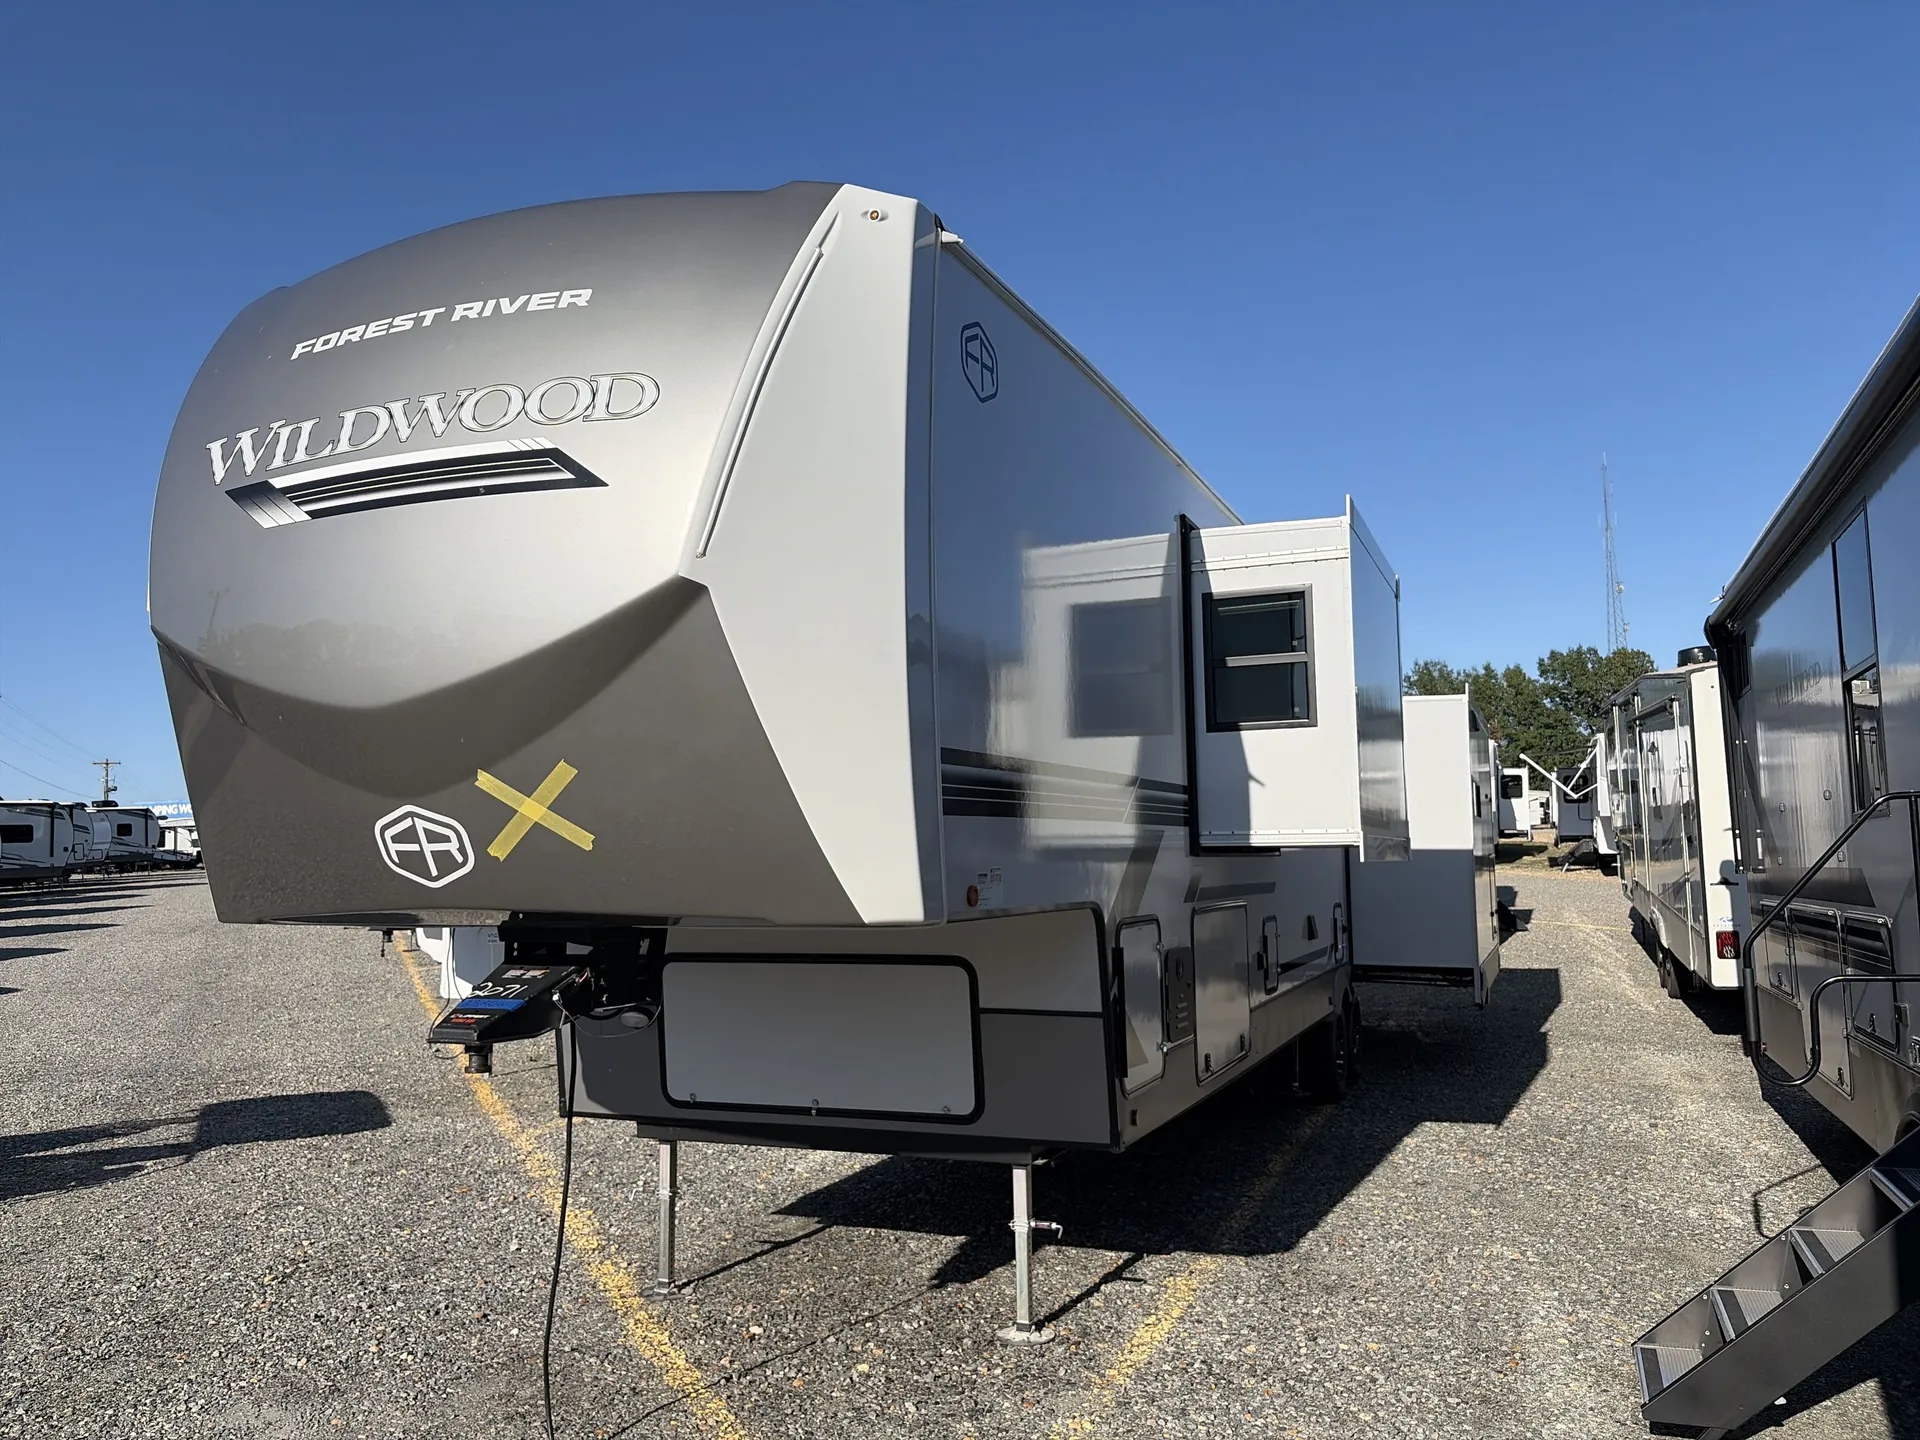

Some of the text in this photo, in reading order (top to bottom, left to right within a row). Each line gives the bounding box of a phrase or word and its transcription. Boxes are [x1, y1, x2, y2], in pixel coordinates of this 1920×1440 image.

[290, 288, 593, 361] FOREST RIVER
[204, 371, 661, 486] WILDWOOD
[383, 816, 465, 878] FR
[467, 981, 529, 999] 2071
